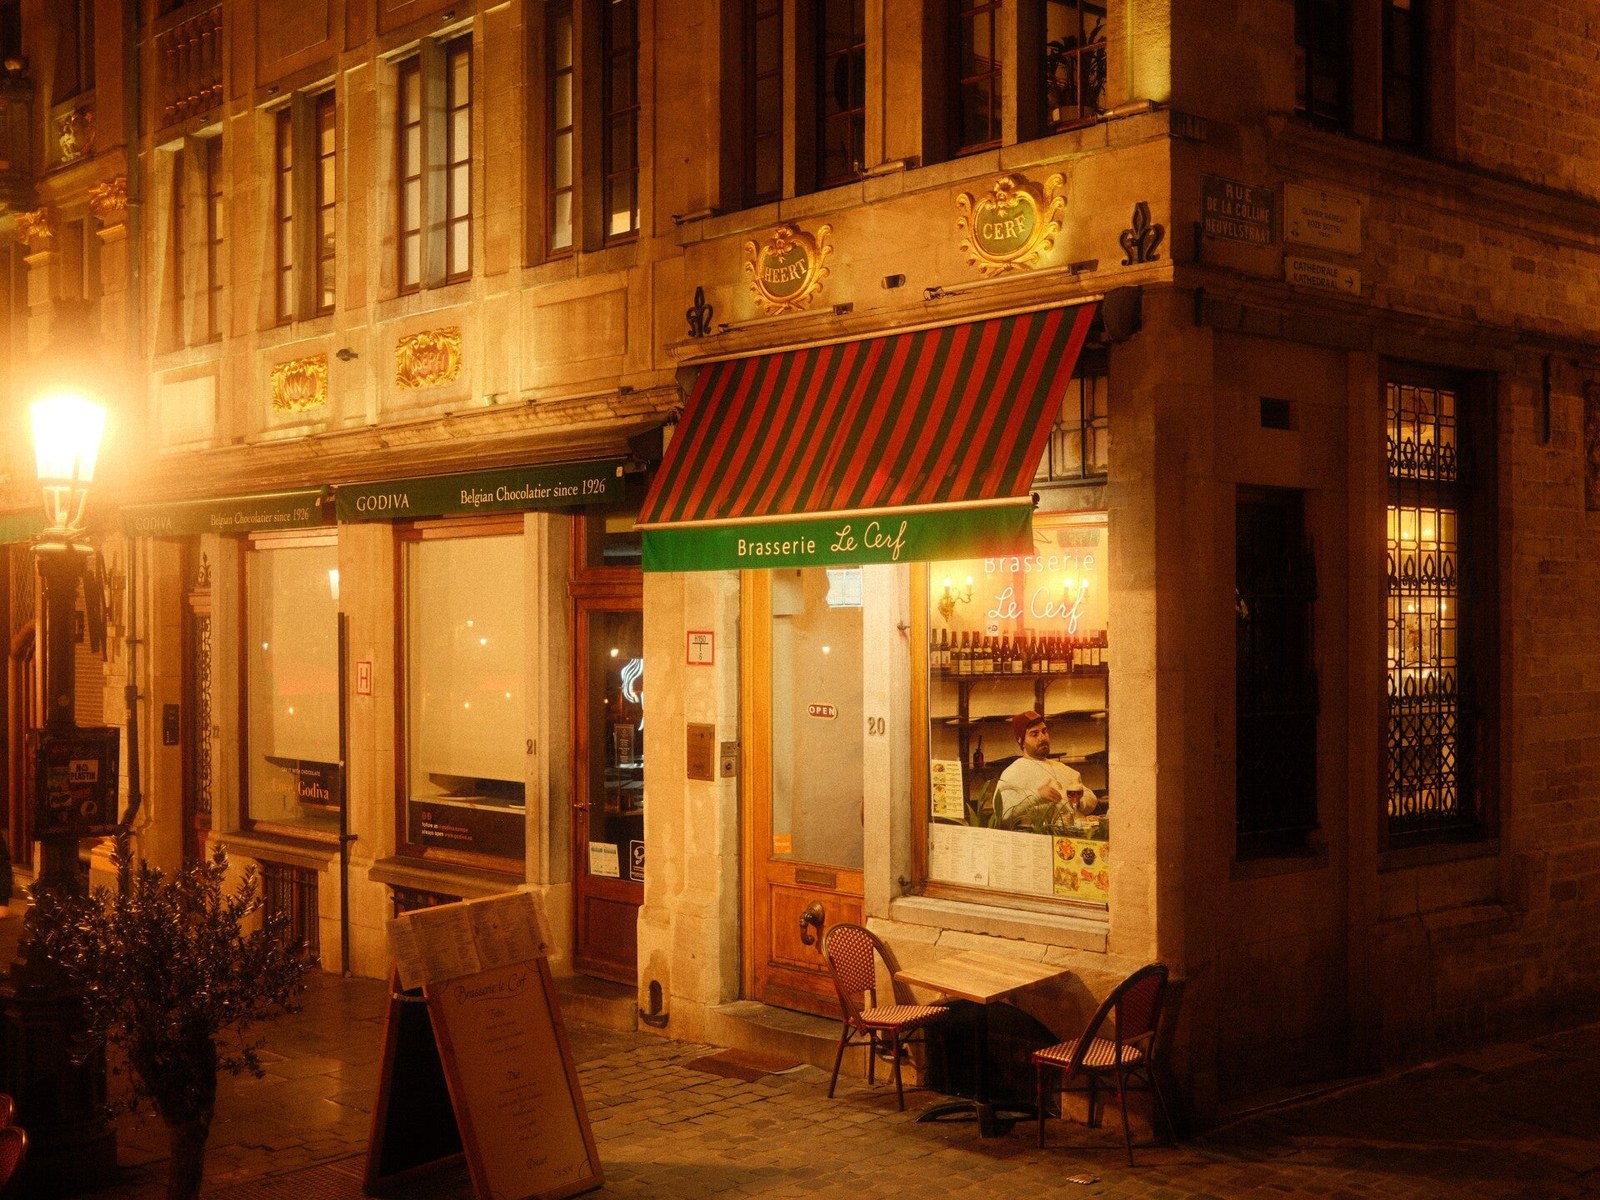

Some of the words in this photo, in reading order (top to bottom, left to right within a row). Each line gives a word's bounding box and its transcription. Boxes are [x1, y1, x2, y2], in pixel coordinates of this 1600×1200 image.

[1225, 183, 1252, 203] RUE
[1206, 196, 1218, 212] DE
[1221, 199, 1232, 215] LA
[1235, 202, 1270, 223] COLLINE
[982, 215, 1028, 241] CERF
[1205, 217, 1271, 243] HEUVELSTRAAT
[763, 258, 806, 284] HEERT
[1293, 272, 1338, 290] KATHEDRAAL
[356, 493, 410, 511] GODIVA
[460, 488, 494, 508] Belgian
[496, 482, 551, 501] Chocolatier
[552, 481, 579, 498] since
[581, 478, 606, 495] 1926
[135, 517, 172, 531] GODIVA
[210, 513, 233, 528] Belgian
[234, 510, 273, 525] Chocolatier
[273, 509, 291, 522] since
[292, 507, 309, 521] 1926
[737, 536, 817, 556] Brasserie
[830, 525, 858, 552] Le
[863, 520, 907, 561] Cerf
[984, 553, 1095, 574] Brasserie
[987, 586, 1023, 619] Le
[1030, 585, 1086, 635] Cerf
[809, 705, 836, 717] OPEN
[867, 716, 886, 736] 20
[526, 738, 537, 756] 21
[298, 781, 329, 800] Godiva
